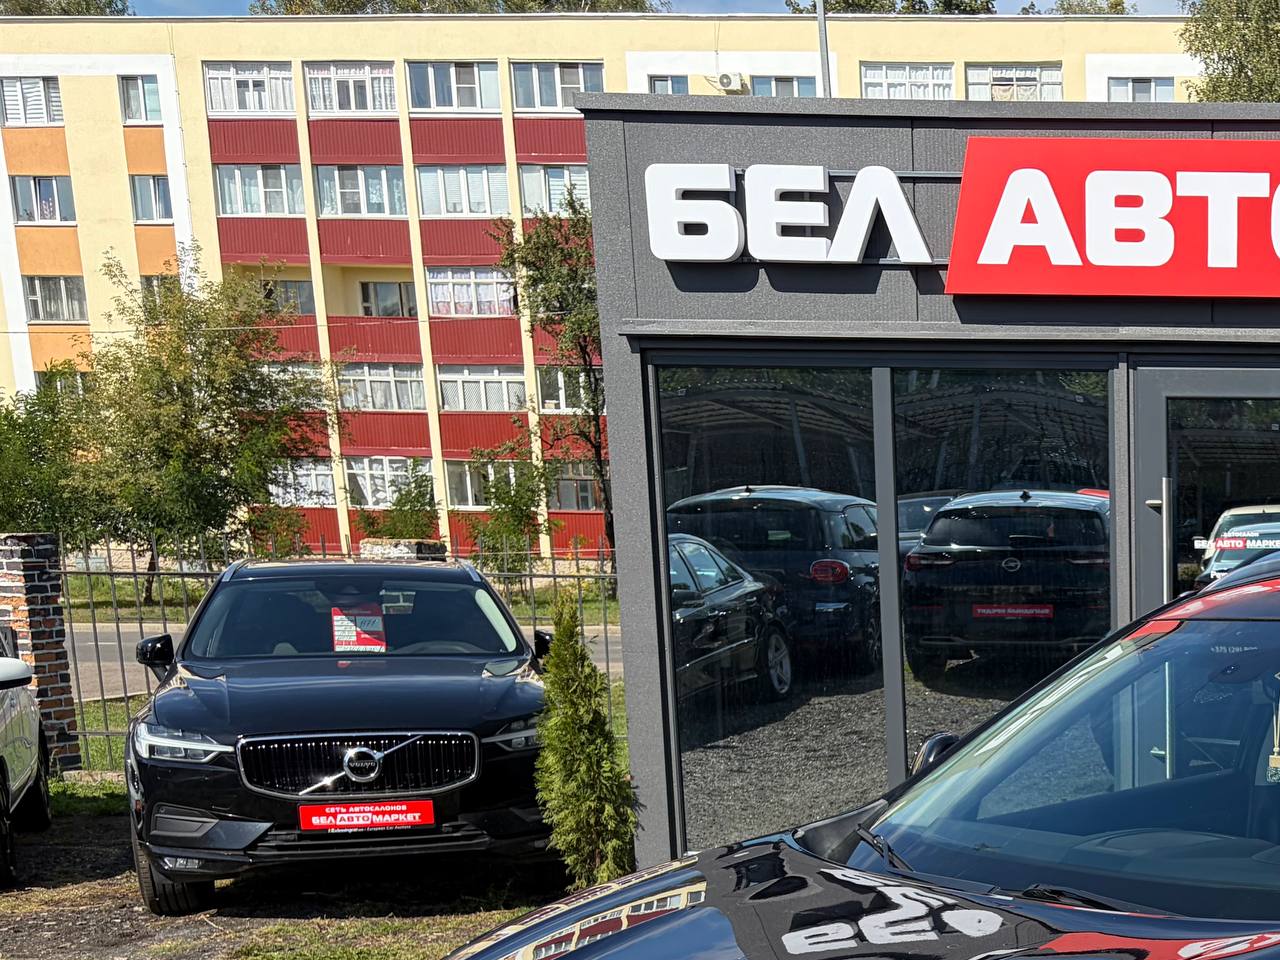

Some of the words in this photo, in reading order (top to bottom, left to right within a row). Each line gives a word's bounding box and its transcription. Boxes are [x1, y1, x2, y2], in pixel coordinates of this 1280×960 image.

[644, 163, 934, 264] БЕЛ
[1217, 540, 1243, 548] АВТО
[372, 813, 421, 823] МАРКЕТ
